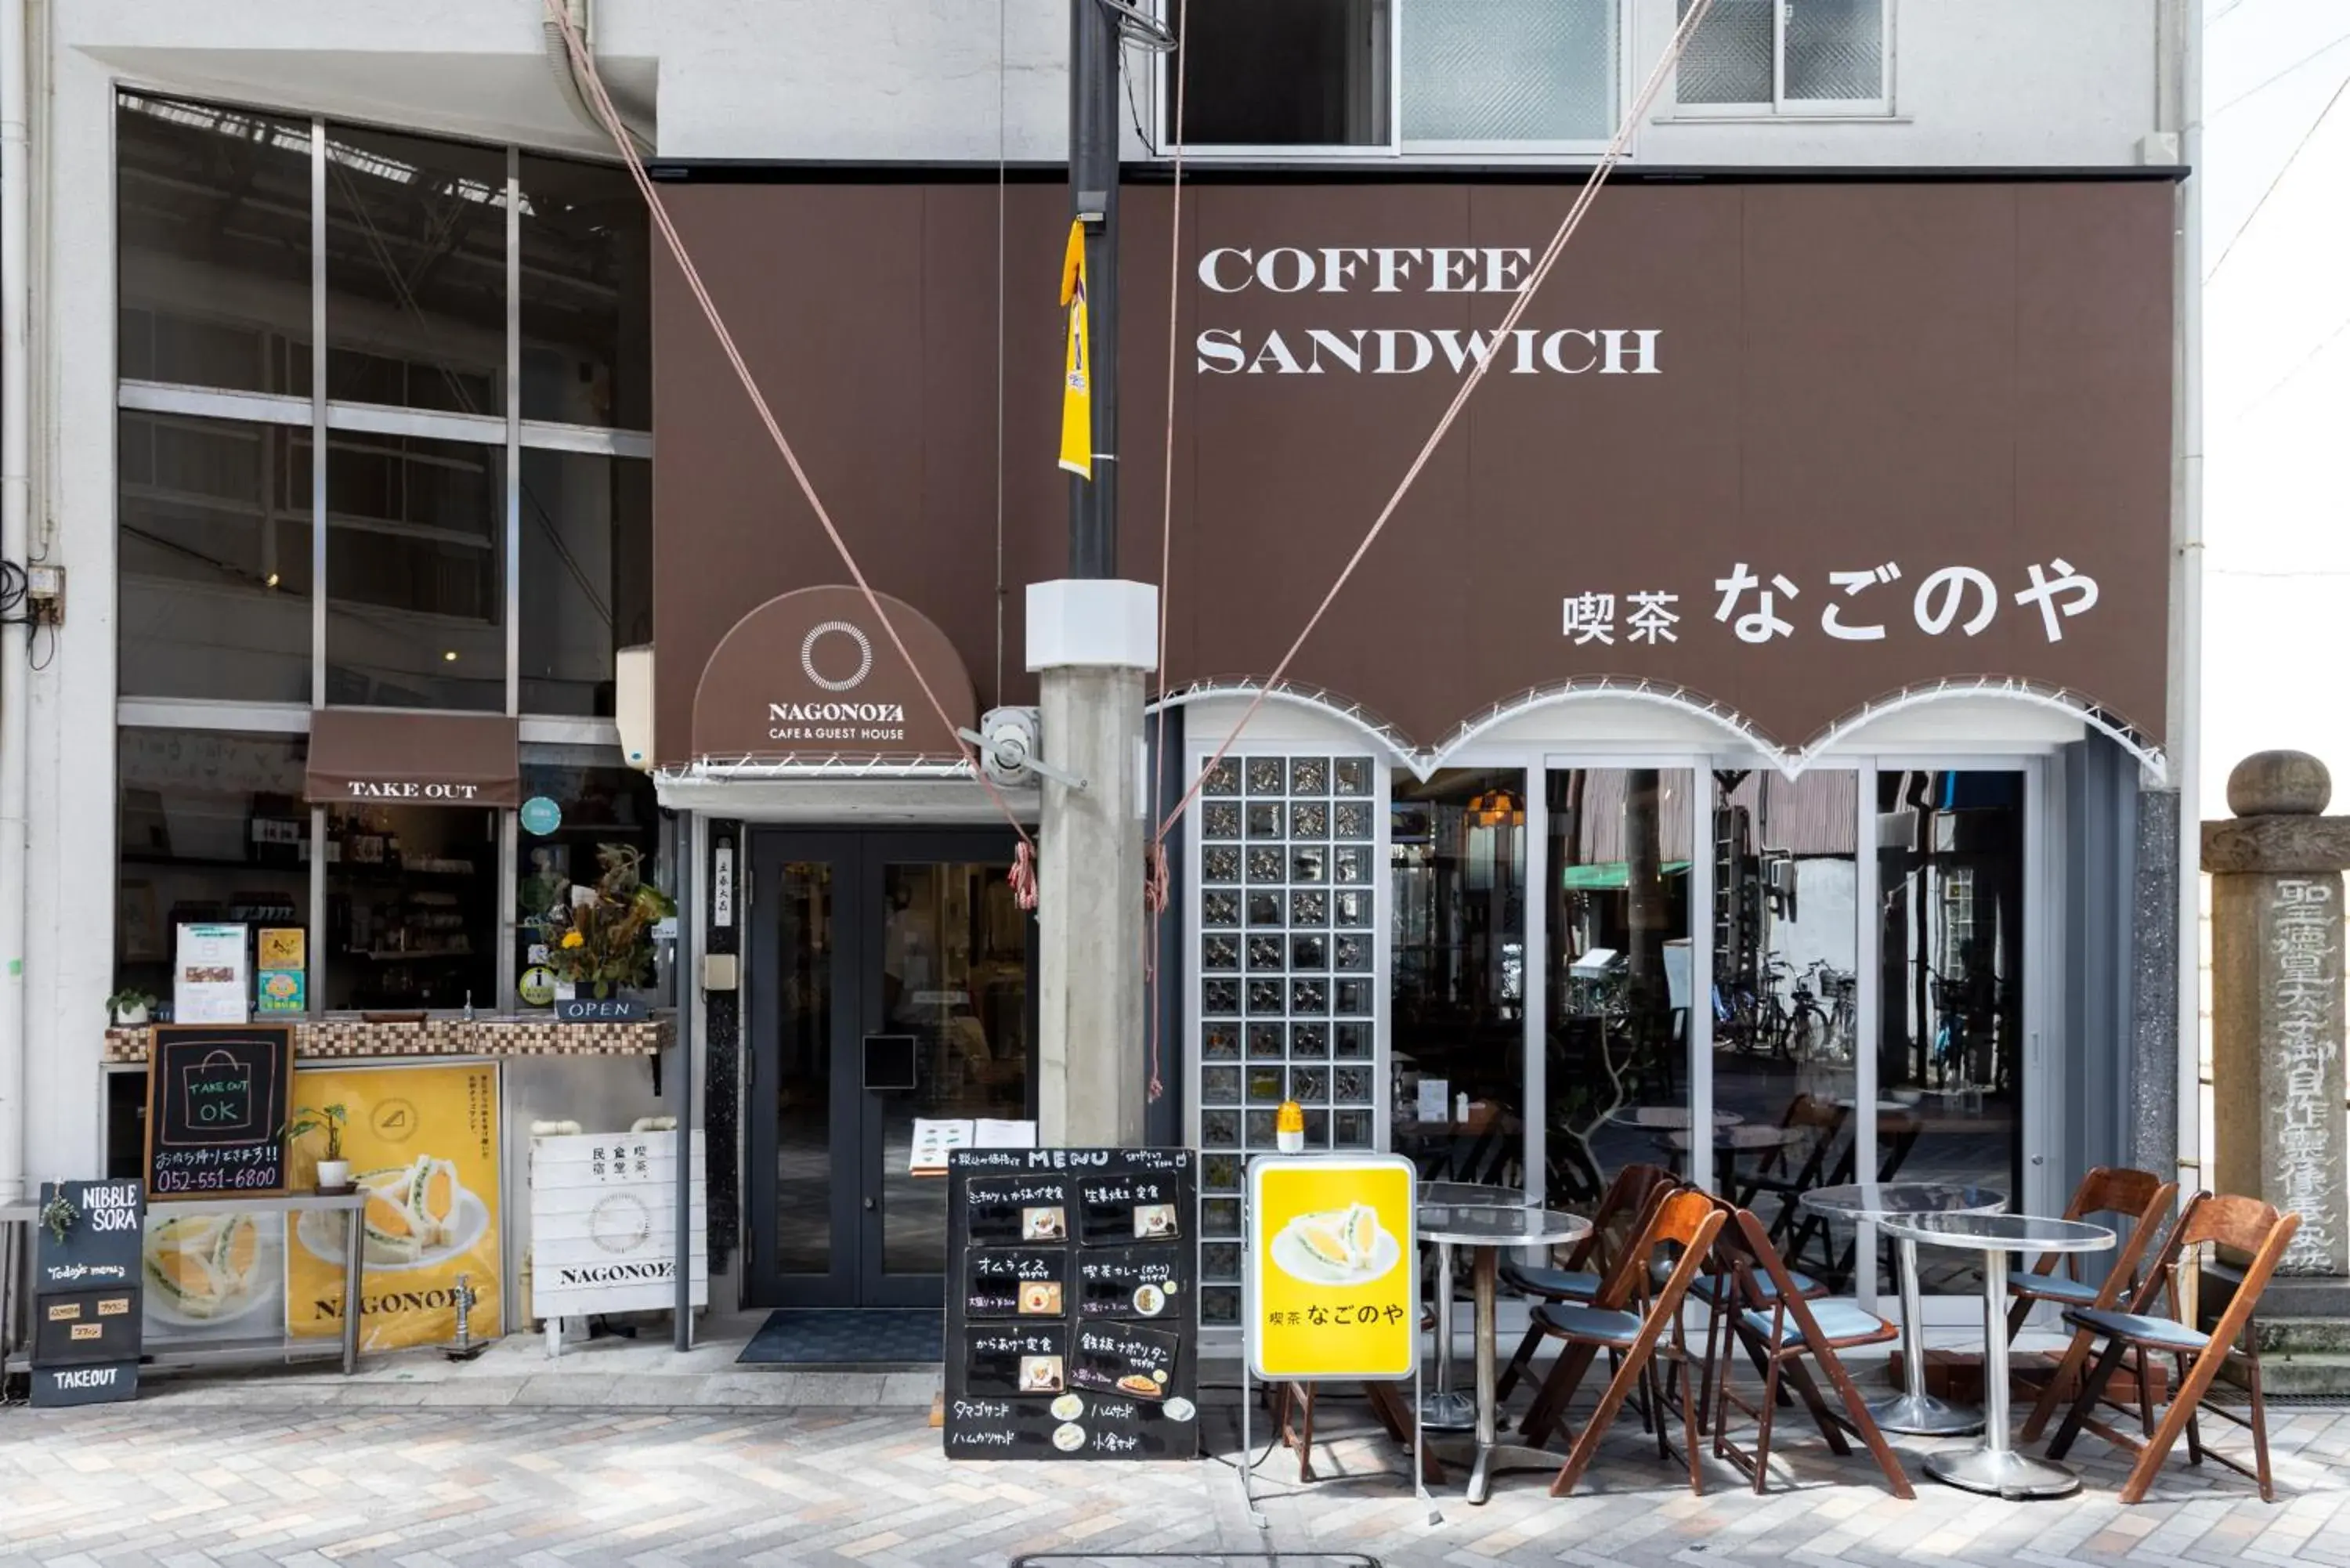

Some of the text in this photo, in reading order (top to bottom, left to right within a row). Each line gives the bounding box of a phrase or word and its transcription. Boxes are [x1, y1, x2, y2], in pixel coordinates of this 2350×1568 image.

[1197, 247, 1533, 293] COFFEE
[1196, 328, 1663, 374] SANDWICH
[1562, 557, 2100, 645] 喫茶 なごのや
[768, 702, 905, 722] NAGONOYA
[768, 727, 904, 740] CAFE & GUEST HOUSE
[348, 780, 478, 800] TAKE OUT
[568, 1003, 631, 1017] OPEN
[189, 1080, 249, 1095] TAKE OUT
[200, 1101, 239, 1121] OK
[1029, 1150, 1109, 1169] MENU
[157, 1167, 277, 1191] 052-551-6800
[82, 1184, 137, 1209] NIBBLE
[92, 1209, 138, 1231] SORA
[1269, 1303, 1404, 1326] 喫茶 なごのや
[54, 1367, 118, 1389] TAKEOUT
